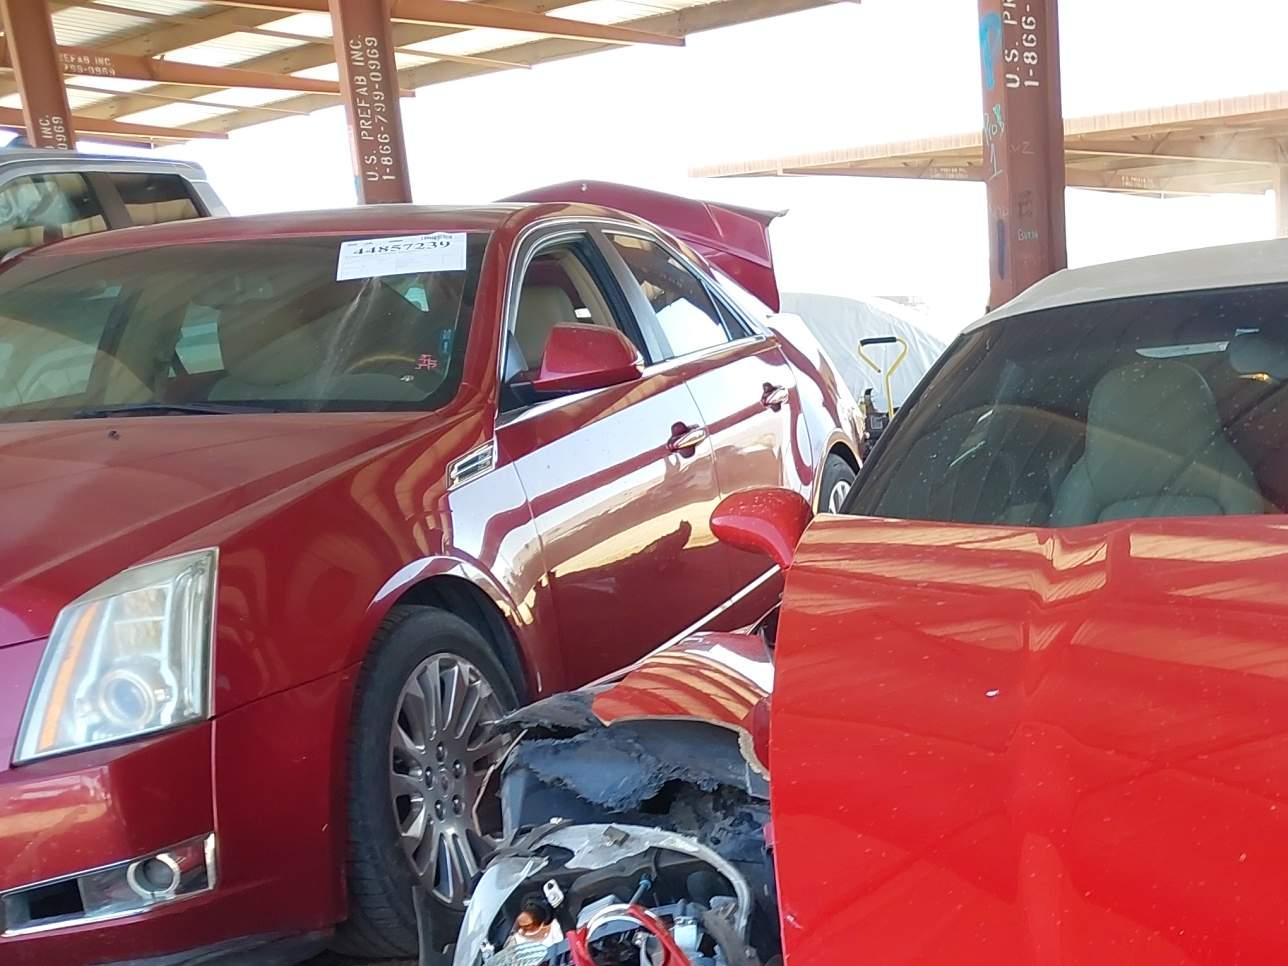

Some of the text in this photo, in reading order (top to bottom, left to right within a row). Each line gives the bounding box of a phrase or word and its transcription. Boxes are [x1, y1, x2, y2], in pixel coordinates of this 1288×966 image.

[349, 34, 379, 181] U.S. PREFAB INC.
[364, 36, 397, 180] 1-866-799-0969
[1004, 41, 1020, 88] U.S.
[352, 240, 452, 256] 44857239
